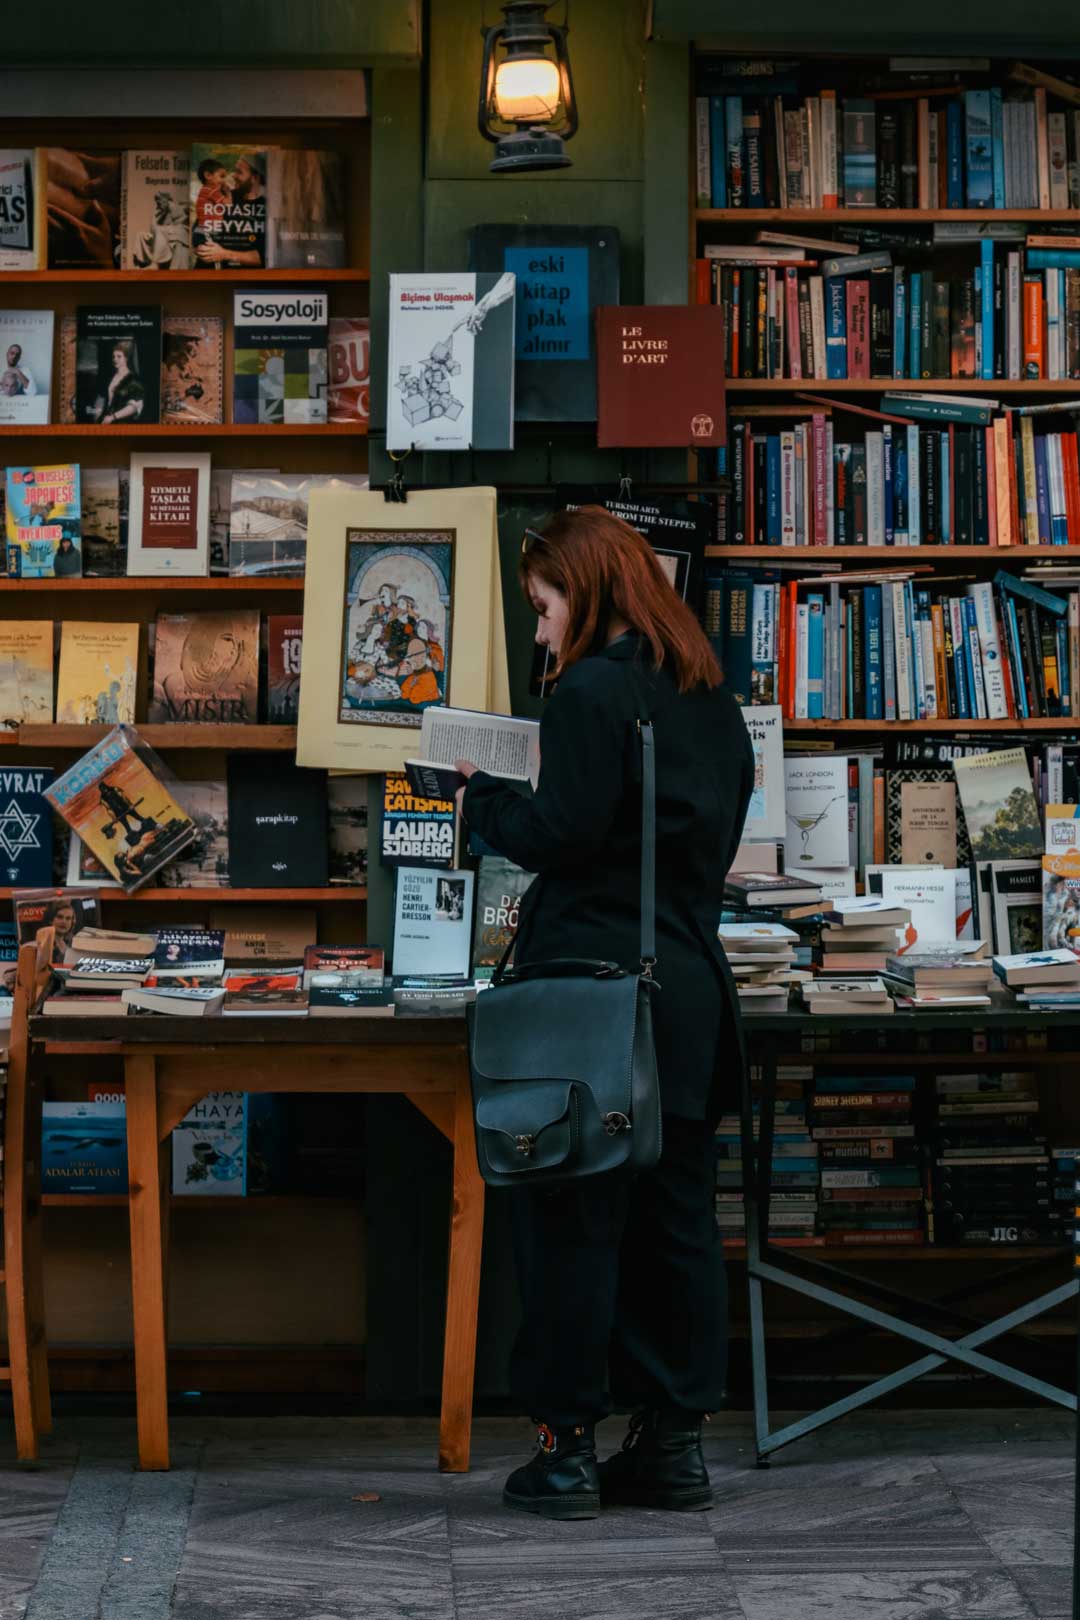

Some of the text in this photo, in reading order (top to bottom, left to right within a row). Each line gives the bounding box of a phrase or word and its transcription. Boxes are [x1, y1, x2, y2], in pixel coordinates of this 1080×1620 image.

[748, 136, 761, 196] THESAURUS
[203, 203, 266, 217] ROTASIZ
[203, 219, 265, 234] SEYYAH
[528, 255, 565, 273] eski
[400, 293, 474, 304] Biçime Ulaşmak
[522, 282, 571, 307] kitap
[829, 283, 843, 309] Jackie
[240, 299, 323, 322] Sosyoloji
[527, 308, 568, 331] plak
[622, 327, 642, 337] LE
[622, 340, 668, 350] LIVRE
[622, 353, 668, 364] D'ART
[24, 485, 74, 504] JAPANESE
[150, 485, 191, 494] KIYMETLİ
[150, 495, 190, 504] TAŞLAR
[606, 500, 660, 515] TURKISH ARTS
[611, 510, 697, 530] FROM THE STEPPES
[869, 628, 878, 650] TOEFL
[765, 718, 777, 726] of
[751, 729, 766, 740] is
[938, 745, 962, 762] OLD
[385, 779, 413, 794] SAV
[382, 820, 454, 843] LAURA
[1009, 875, 1036, 884] HAMLET
[402, 894, 423, 902] HENRI
[402, 902, 432, 912] CARTIER-
[401, 911, 432, 921] BRESSON
[814, 1095, 873, 1106] SIDNEY SHELDON
[44, 1166, 86, 1177] ADALAR
[990, 1226, 1018, 1242] JIG
